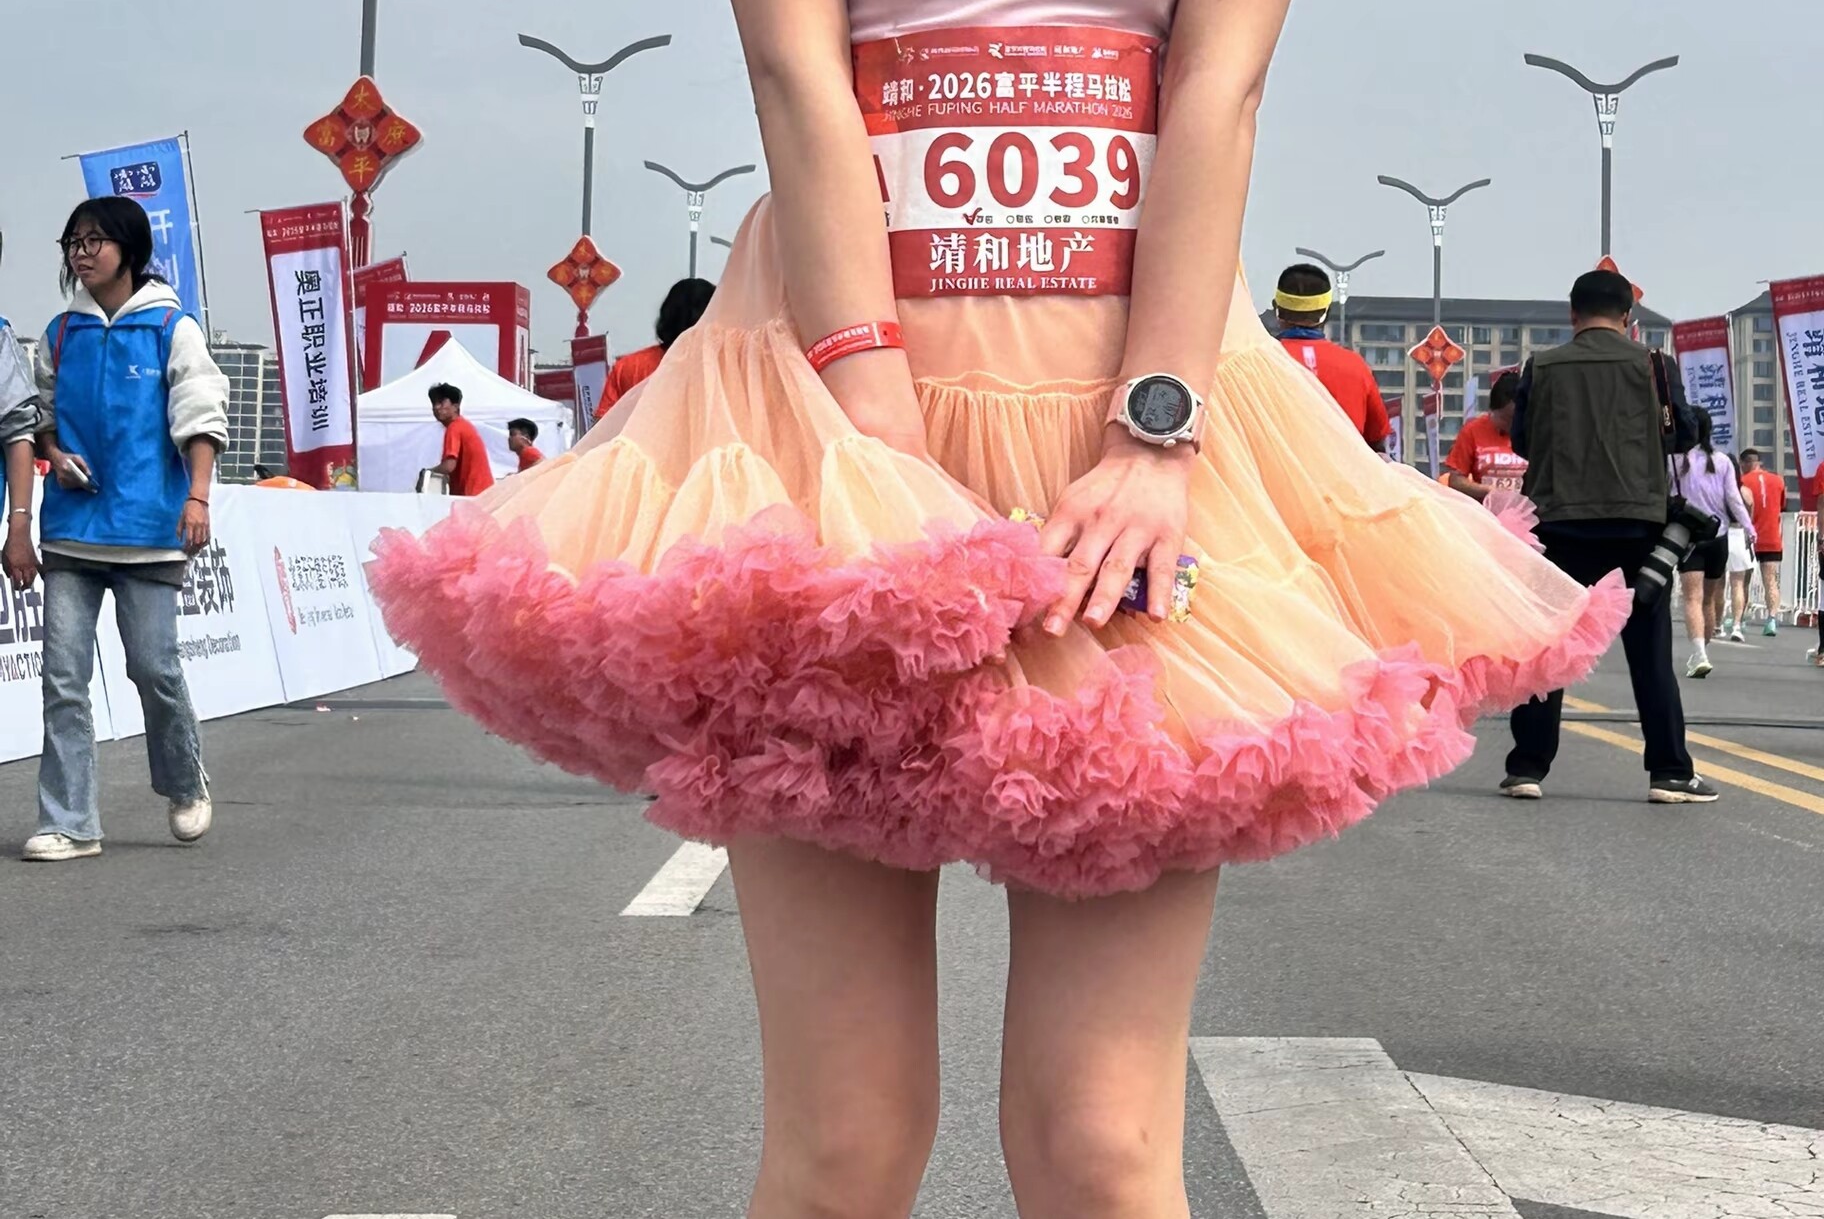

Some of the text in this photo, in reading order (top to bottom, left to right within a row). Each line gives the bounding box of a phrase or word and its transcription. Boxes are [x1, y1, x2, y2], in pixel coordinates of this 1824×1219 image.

[928, 101, 982, 116] FUPING
[989, 101, 1028, 114] HALF
[1034, 101, 1108, 116] MARATHON
[348, 156, 375, 184] 平
[923, 131, 1141, 210] 6039
[929, 230, 1097, 274] 靖和地产
[930, 277, 1097, 292] JINGHE REAL ESTATE
[295, 269, 330, 432] 奥正职业培训
